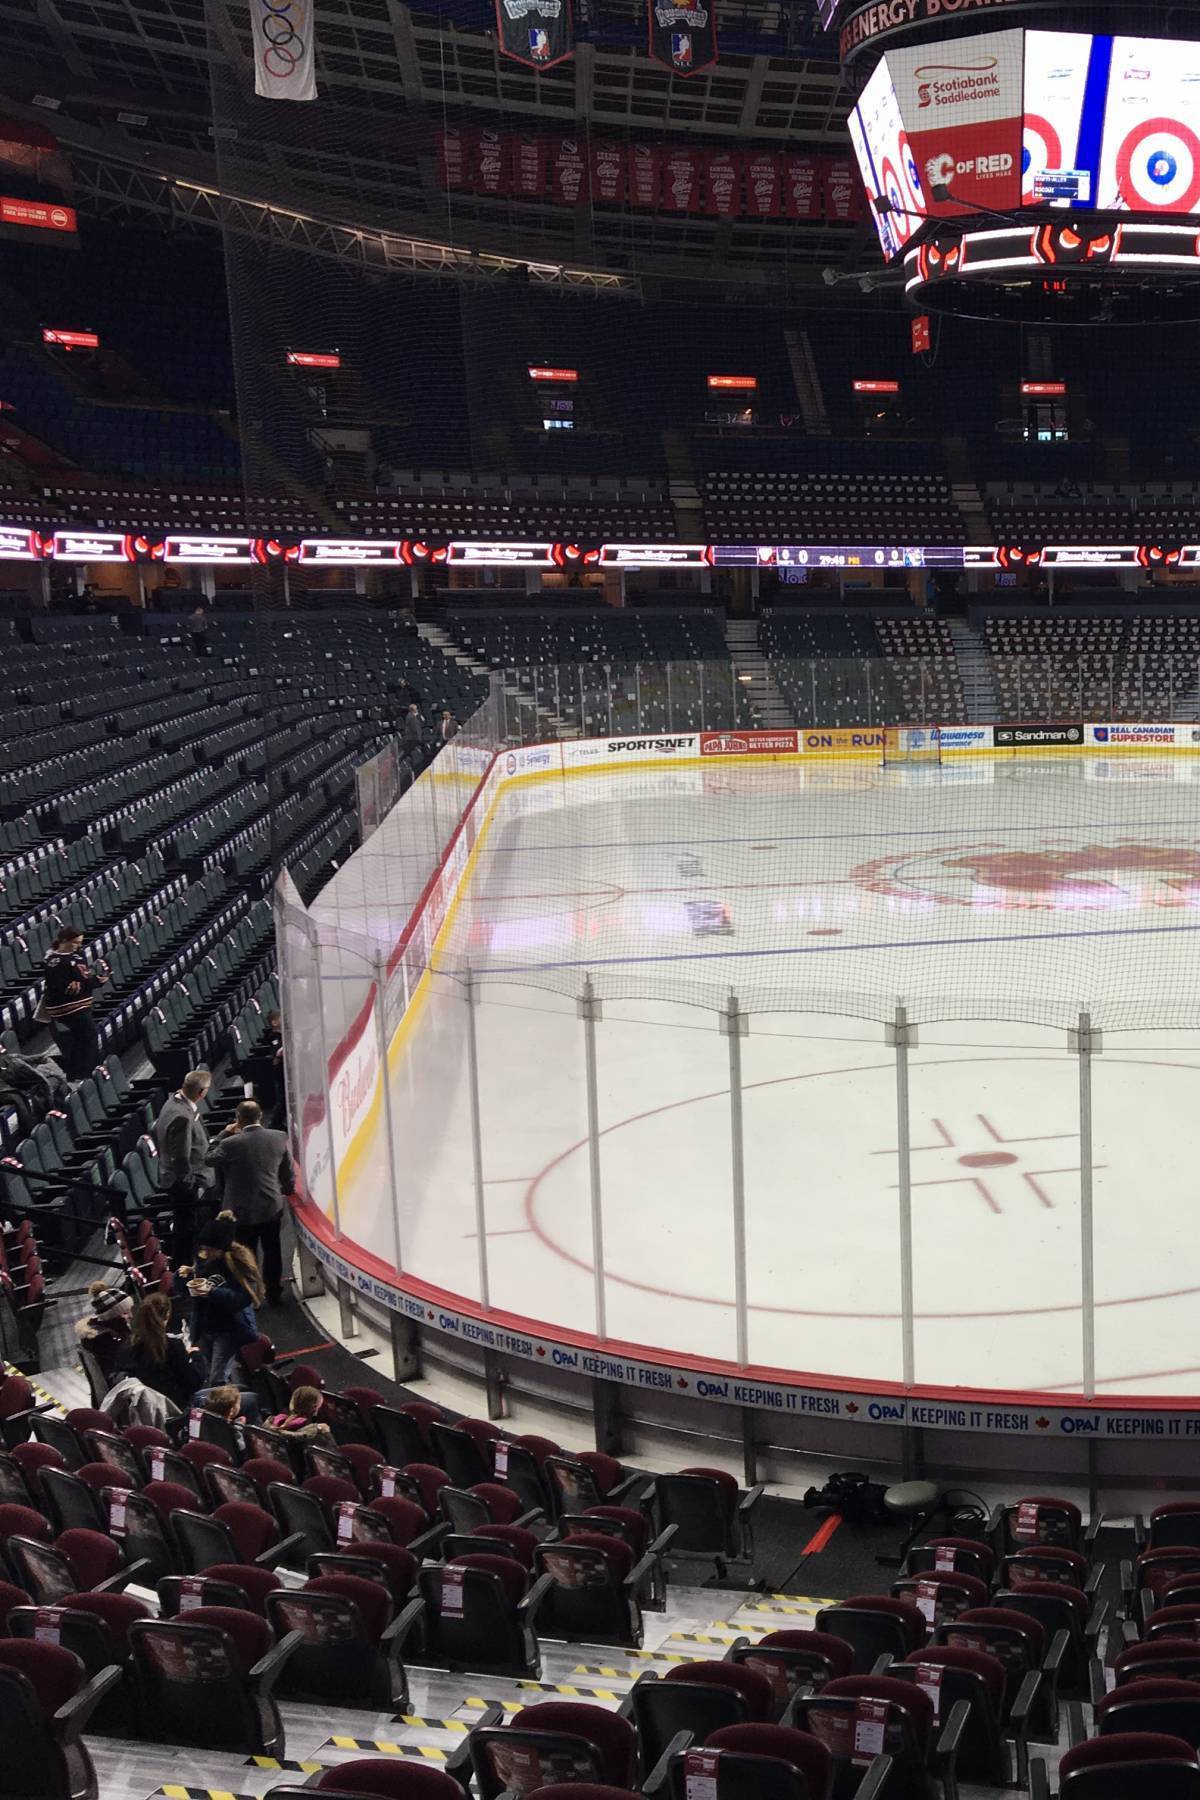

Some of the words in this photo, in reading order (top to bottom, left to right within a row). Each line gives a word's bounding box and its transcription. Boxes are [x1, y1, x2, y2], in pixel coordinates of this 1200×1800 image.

[933, 73, 998, 93] Scotiabank
[934, 87, 1000, 106] Saddledome
[956, 160, 974, 175] OF
[976, 153, 1013, 173] RED
[608, 737, 696, 752] SPORTSNET
[807, 735, 833, 748] ON
[852, 734, 888, 746] RUN
[1014, 731, 1067, 741] Sandman
[1110, 734, 1175, 742] SUPERSTORE
[374, 1282, 397, 1306] KEEPING
[405, 1298, 425, 1319] FRESH
[462, 1320, 494, 1345] KEEPING
[496, 1333, 504, 1347] IT
[505, 1335, 533, 1356] FRESH
[552, 1349, 578, 1366] OPA!
[582, 1356, 623, 1379] KEEPING
[626, 1366, 636, 1381] IT
[639, 1369, 672, 1389] FRESH
[697, 1380, 729, 1397] OPA!
[734, 1386, 783, 1407] KEEPING
[787, 1394, 797, 1409] IT
[801, 1395, 840, 1414] FRESH
[868, 1403, 905, 1420] OPA!
[912, 1407, 966, 1426] KEEPING
[970, 1411, 982, 1428] IT
[987, 1413, 1029, 1431] FRESH
[1060, 1415, 1101, 1433] OPA!
[1107, 1418, 1164, 1434] KEEPING
[1169, 1419, 1181, 1434] IT
